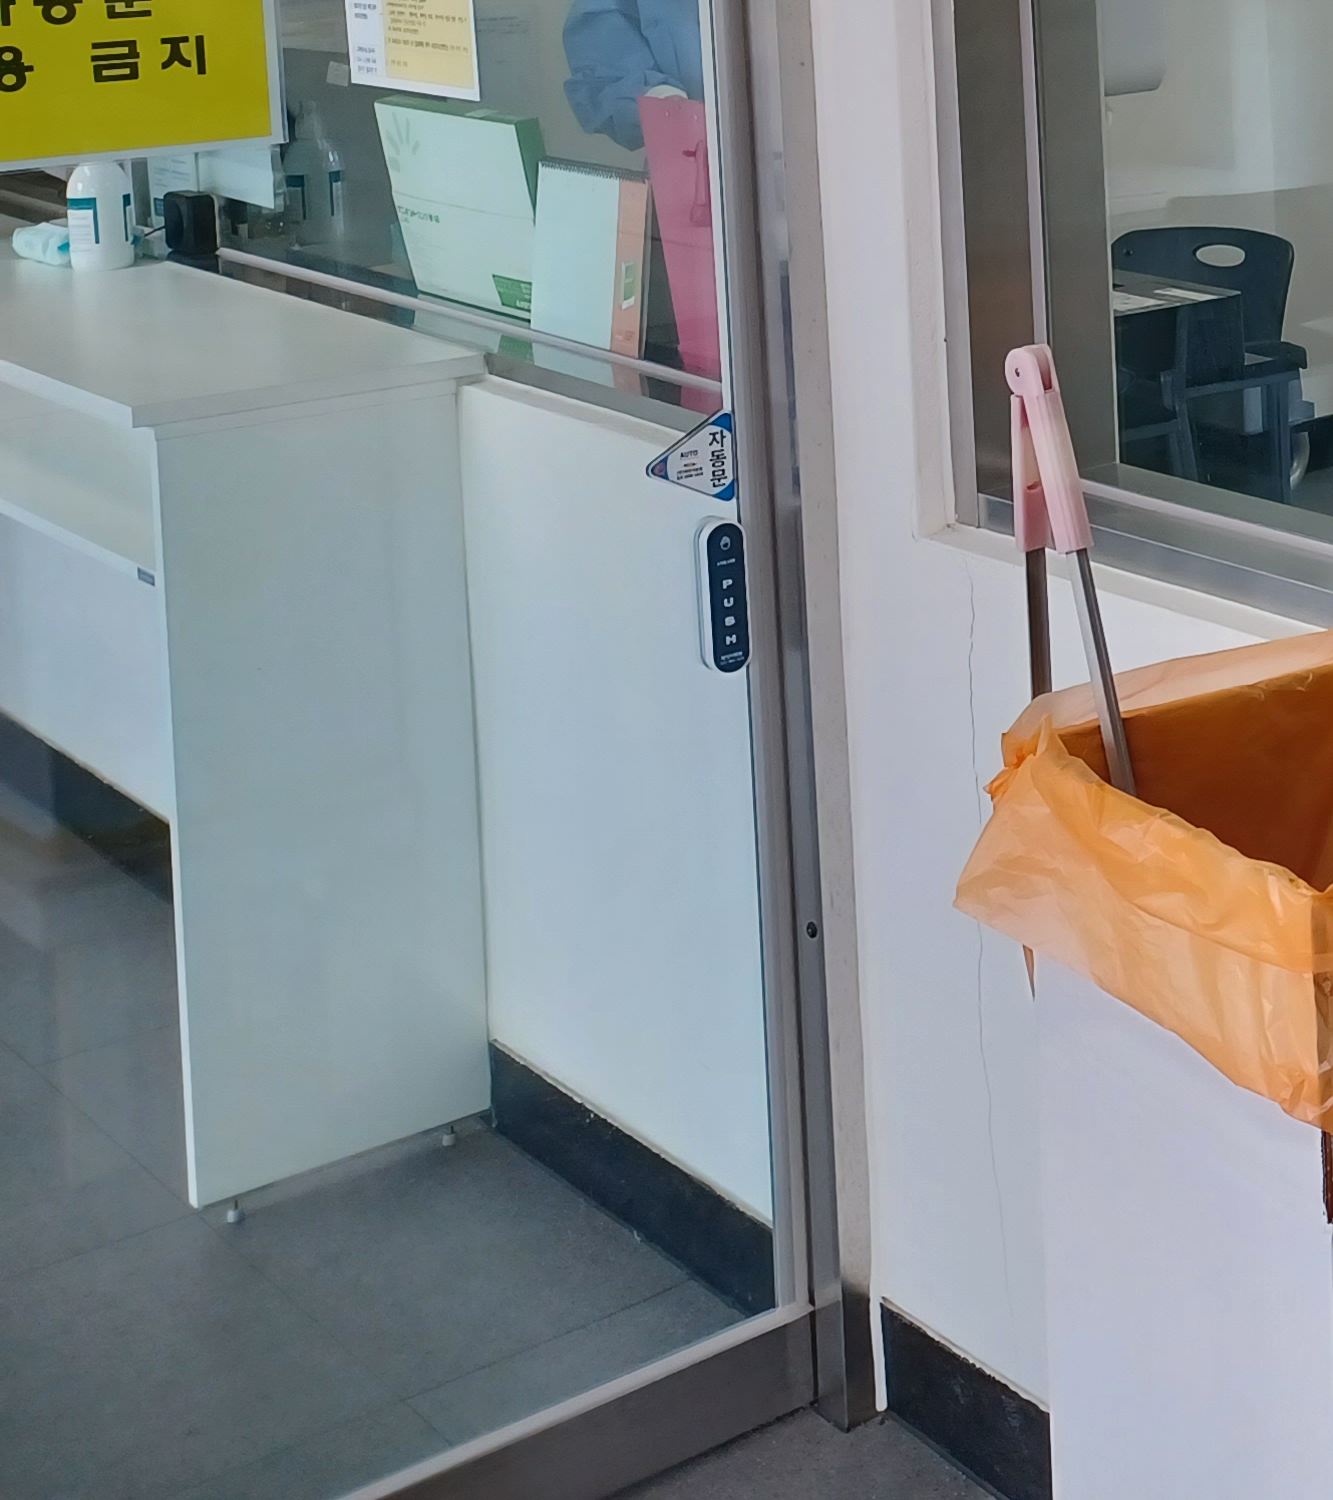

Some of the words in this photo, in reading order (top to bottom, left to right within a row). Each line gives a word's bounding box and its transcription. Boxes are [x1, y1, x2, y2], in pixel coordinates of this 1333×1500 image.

[680, 449, 698, 458] AUTO
[708, 428, 728, 488] 자동문
[722, 578, 738, 646] PUSH
